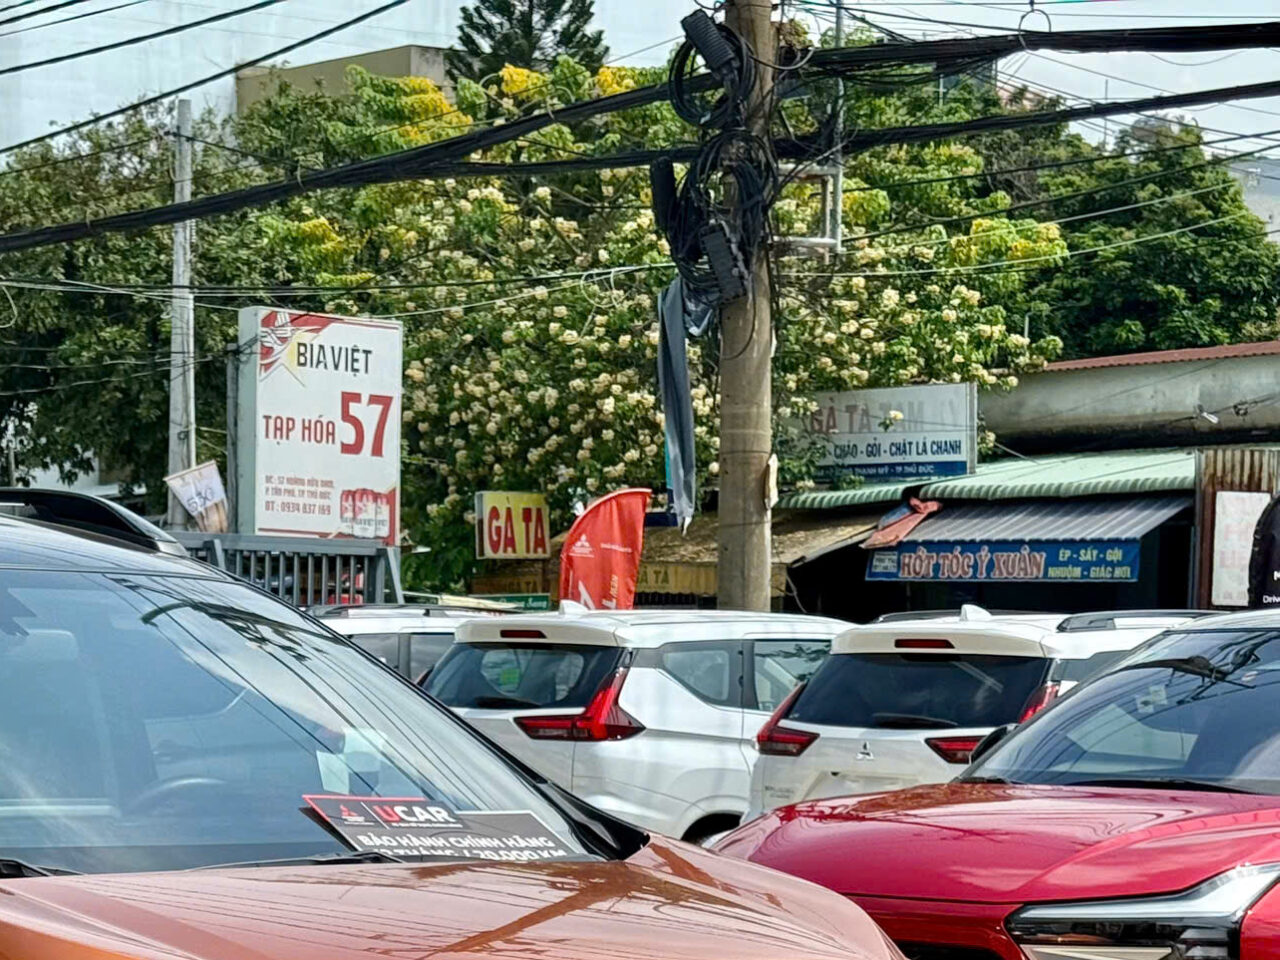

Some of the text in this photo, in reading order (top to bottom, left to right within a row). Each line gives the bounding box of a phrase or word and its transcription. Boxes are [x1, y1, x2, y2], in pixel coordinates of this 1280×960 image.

[263, 415, 336, 445] TẠP HÓA
[340, 391, 394, 458] 57
[916, 437, 928, 456] LÁ
[930, 440, 961, 456] CHANH
[488, 496, 546, 555] GÀ TA
[899, 546, 936, 578] HỚT
[938, 546, 974, 578] TÓC
[976, 545, 991, 578] Ý
[991, 545, 1046, 578] XUÂN
[1059, 548, 1071, 561] ÉP
[1263, 595, 1280, 603] Driv
[373, 805, 457, 823] UCAR
[357, 832, 556, 849] BẢO HÀNH CHÍNH HÃNG
